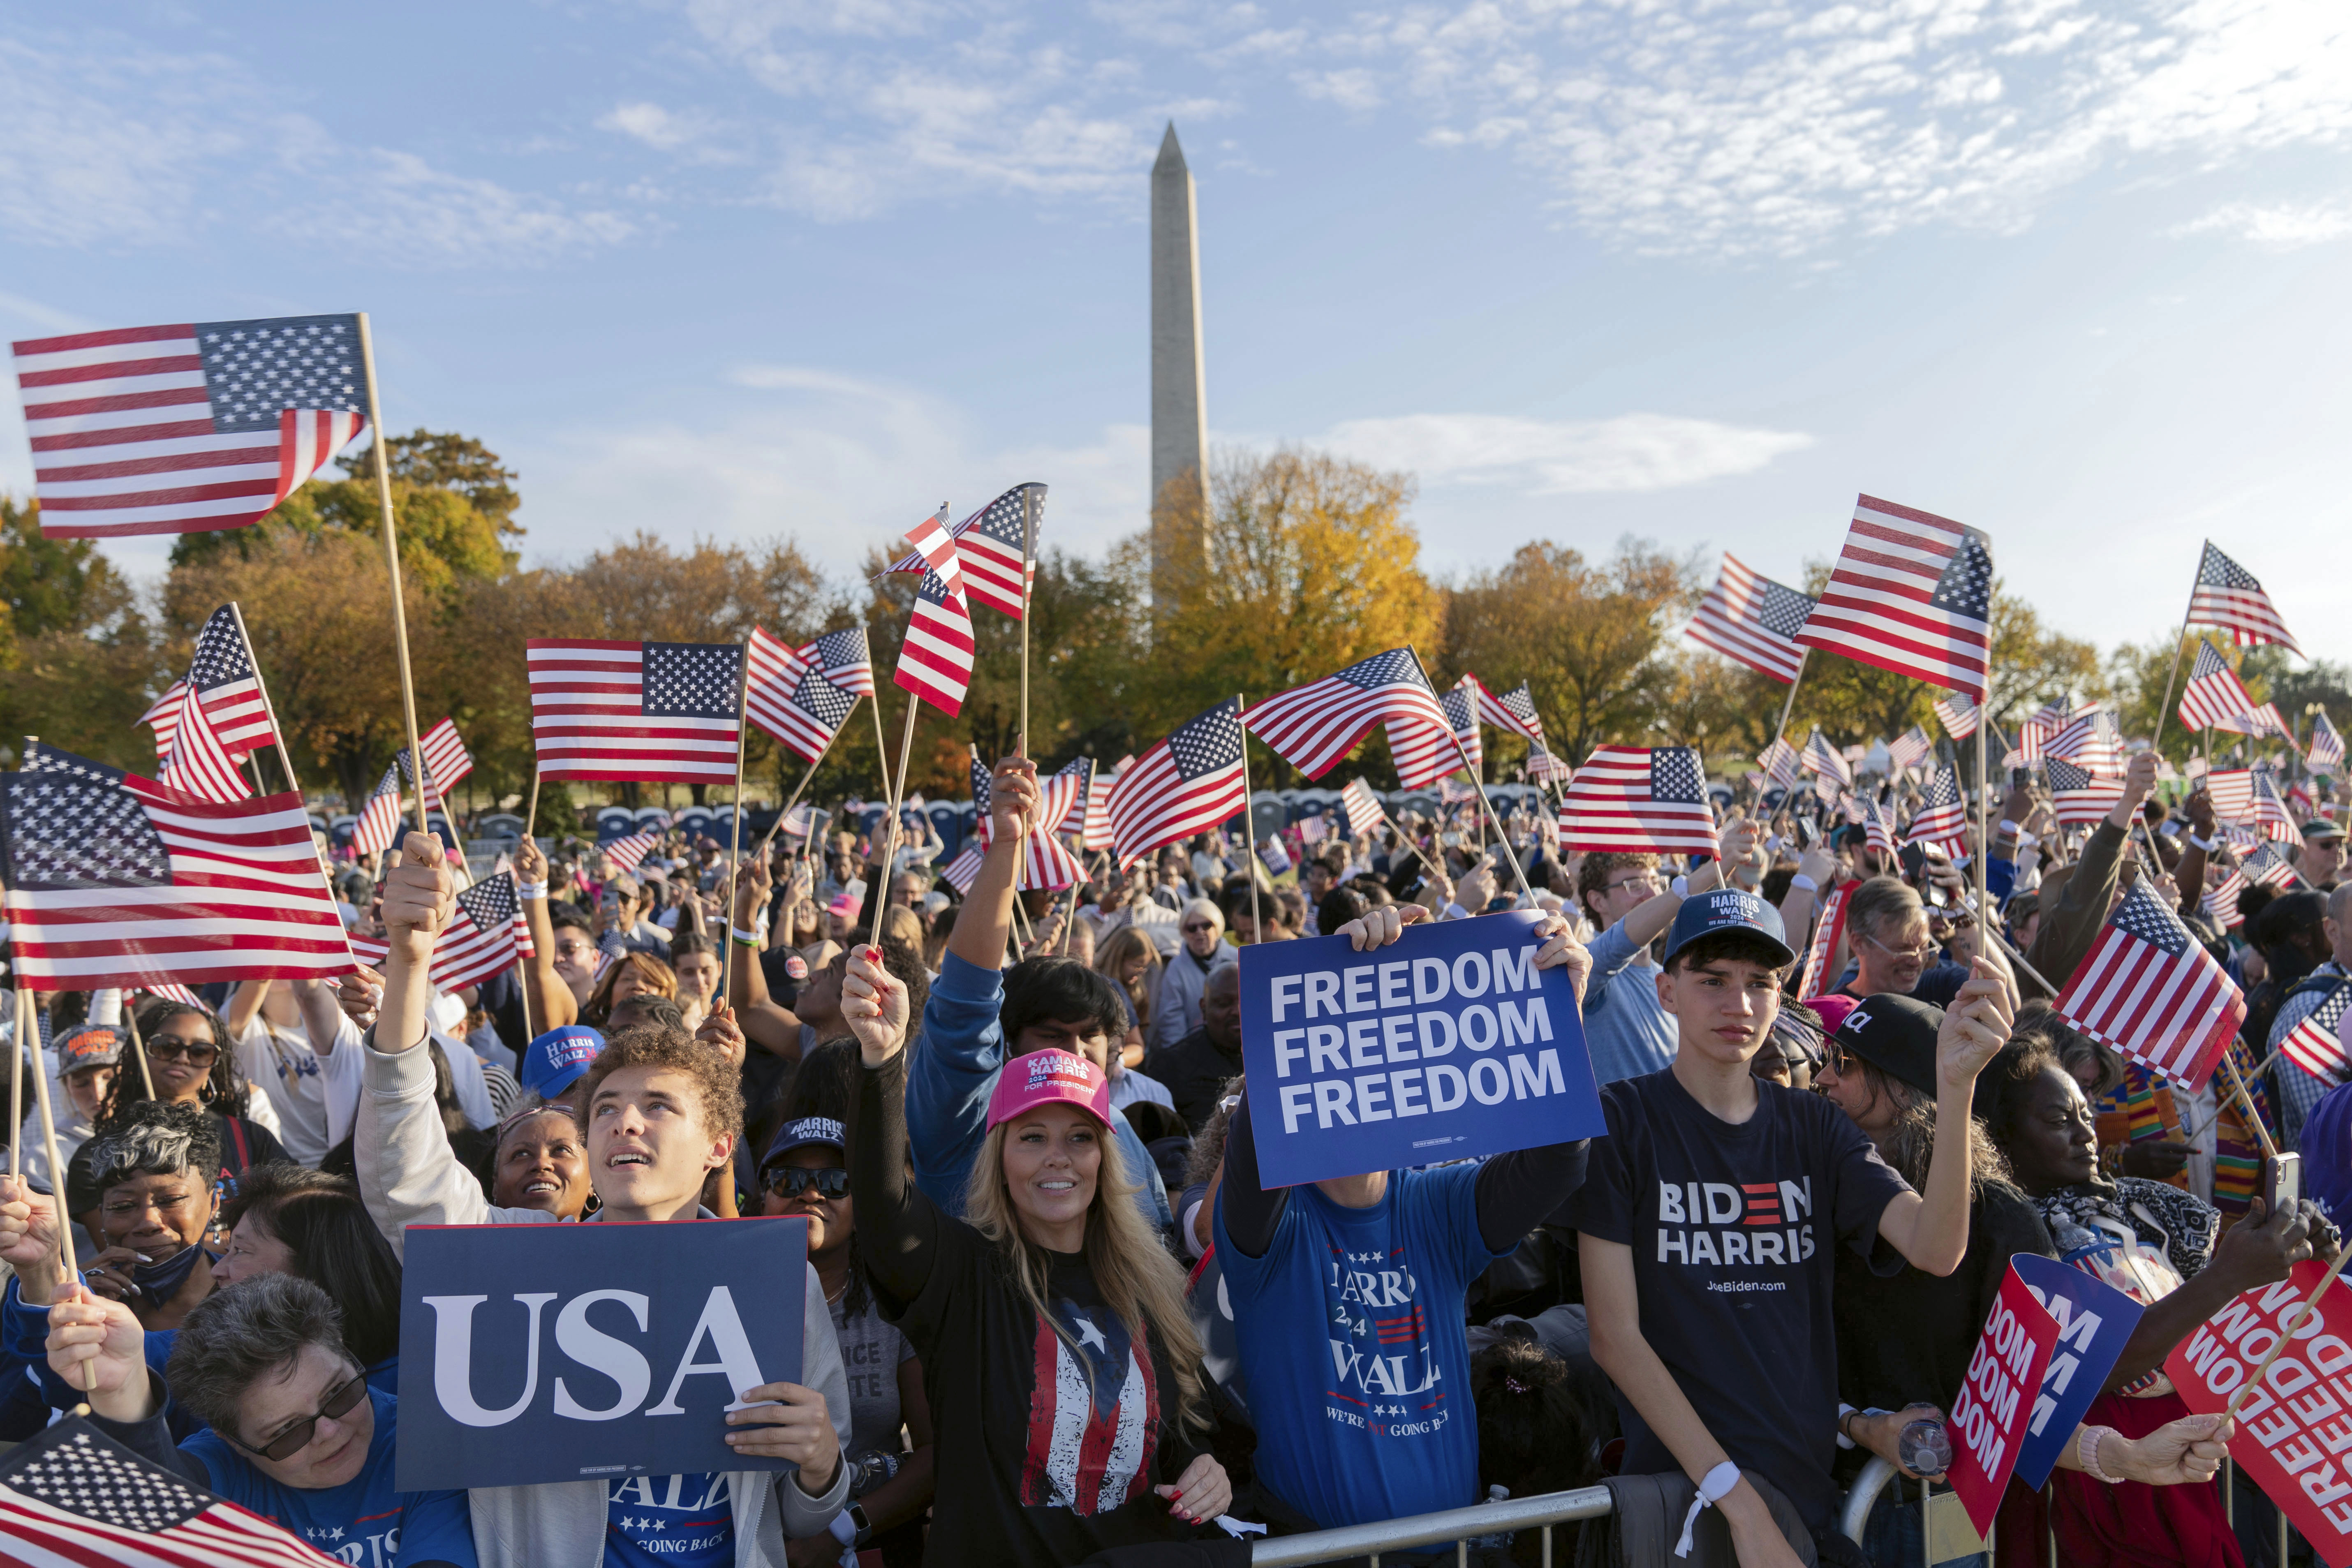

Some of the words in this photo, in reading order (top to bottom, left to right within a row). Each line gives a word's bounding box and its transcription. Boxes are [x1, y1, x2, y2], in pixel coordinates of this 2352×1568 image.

[1711, 894, 1760, 913] HARRIS
[1720, 907, 1754, 919] WALZ
[1272, 945, 1542, 1023] FREEDOM
[68, 1029, 116, 1052] HARRIS
[545, 1038, 595, 1059] HARRIS
[1274, 997, 1554, 1078] FREEDOM
[75, 1043, 109, 1057] WALZ
[549, 1050, 585, 1070] WALZ
[583, 1047, 597, 1059] 24
[1028, 1055, 1090, 1072] KAMALA
[1031, 1064, 1088, 1079] HARRIS
[1025, 1082, 1043, 1092] FOR
[1047, 1080, 1096, 1096] PRESIDENT
[1029, 1075, 1048, 1083] 2024
[1280, 1049, 1566, 1134] FREEDOM
[791, 1117, 843, 1137] HARRIS
[798, 1129, 839, 1142] WALZ
[1659, 1176, 1812, 1225] BIDEN
[1658, 1224, 1815, 1265] HARRIS
[1707, 1280, 1786, 1292] JoeBiden.com
[423, 1286, 782, 1427] USA
[1968, 1335, 2021, 1435] DOM
[1326, 1406, 1364, 1429] WE'RE
[1390, 1421, 1429, 1437] GOING
[1950, 1380, 2006, 1484] DOM
[2184, 1325, 2352, 1536] FREEDOM
[637, 1540, 687, 1554] GOING
